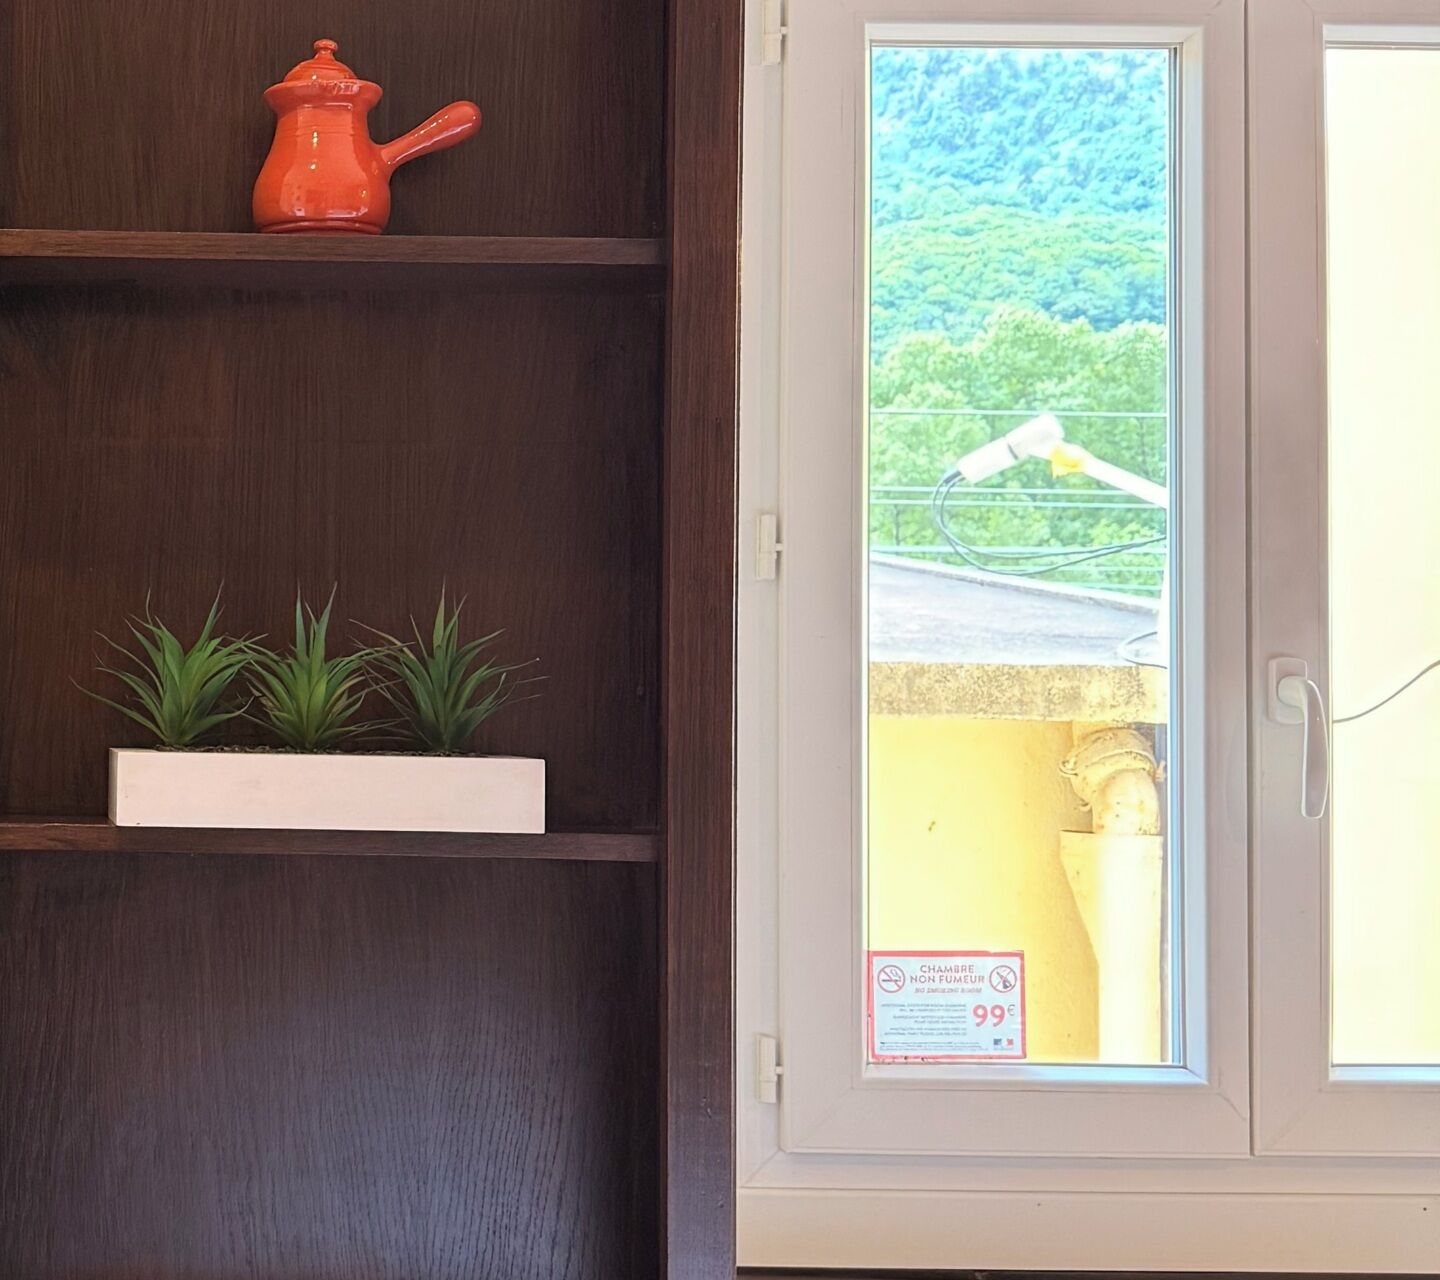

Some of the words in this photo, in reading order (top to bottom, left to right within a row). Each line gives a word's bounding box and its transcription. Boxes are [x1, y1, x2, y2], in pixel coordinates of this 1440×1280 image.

[919, 964, 975, 974] CHAMBRE
[910, 974, 935, 984] NON
[938, 974, 986, 984] FUMEUR
